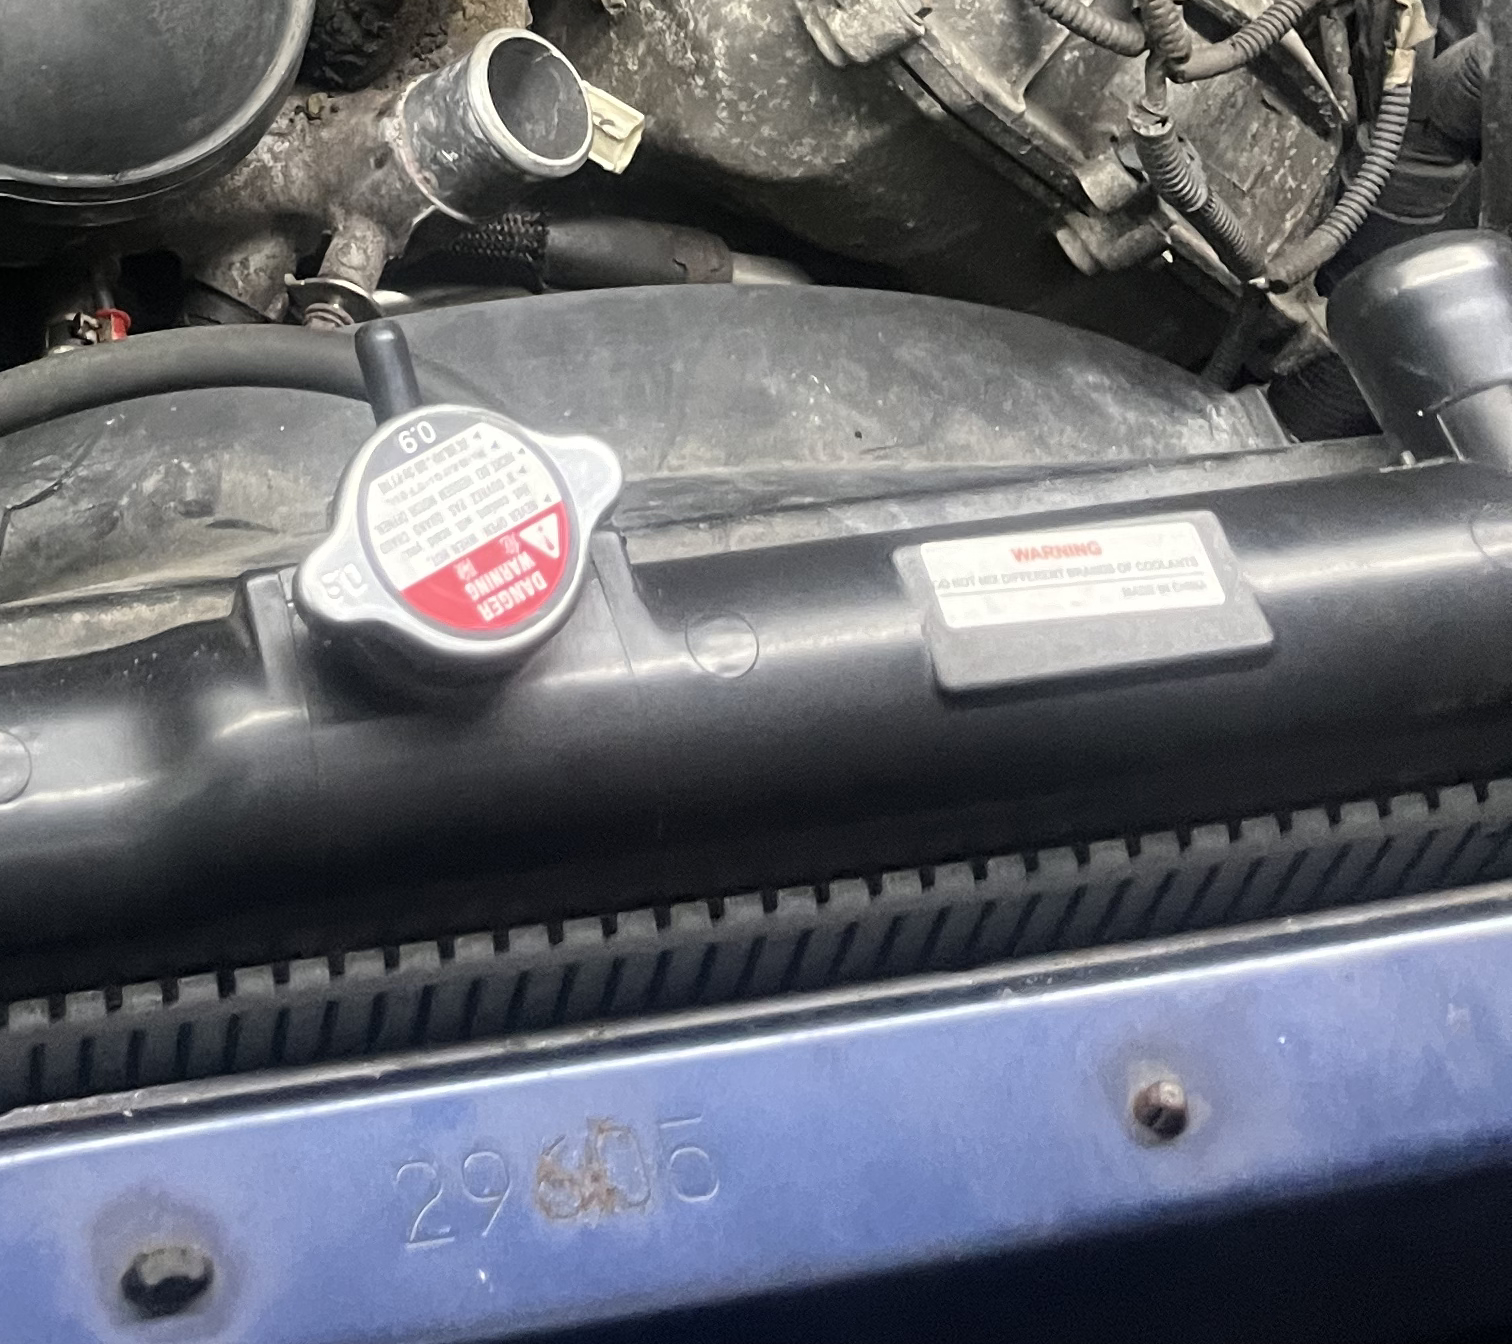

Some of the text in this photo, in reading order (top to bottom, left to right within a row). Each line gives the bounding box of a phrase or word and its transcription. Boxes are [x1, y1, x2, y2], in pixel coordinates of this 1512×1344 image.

[396, 419, 437, 455] 0.9
[1009, 540, 1103, 563] WARNING
[464, 551, 537, 602] WARNING
[476, 569, 548, 623] DANGER
